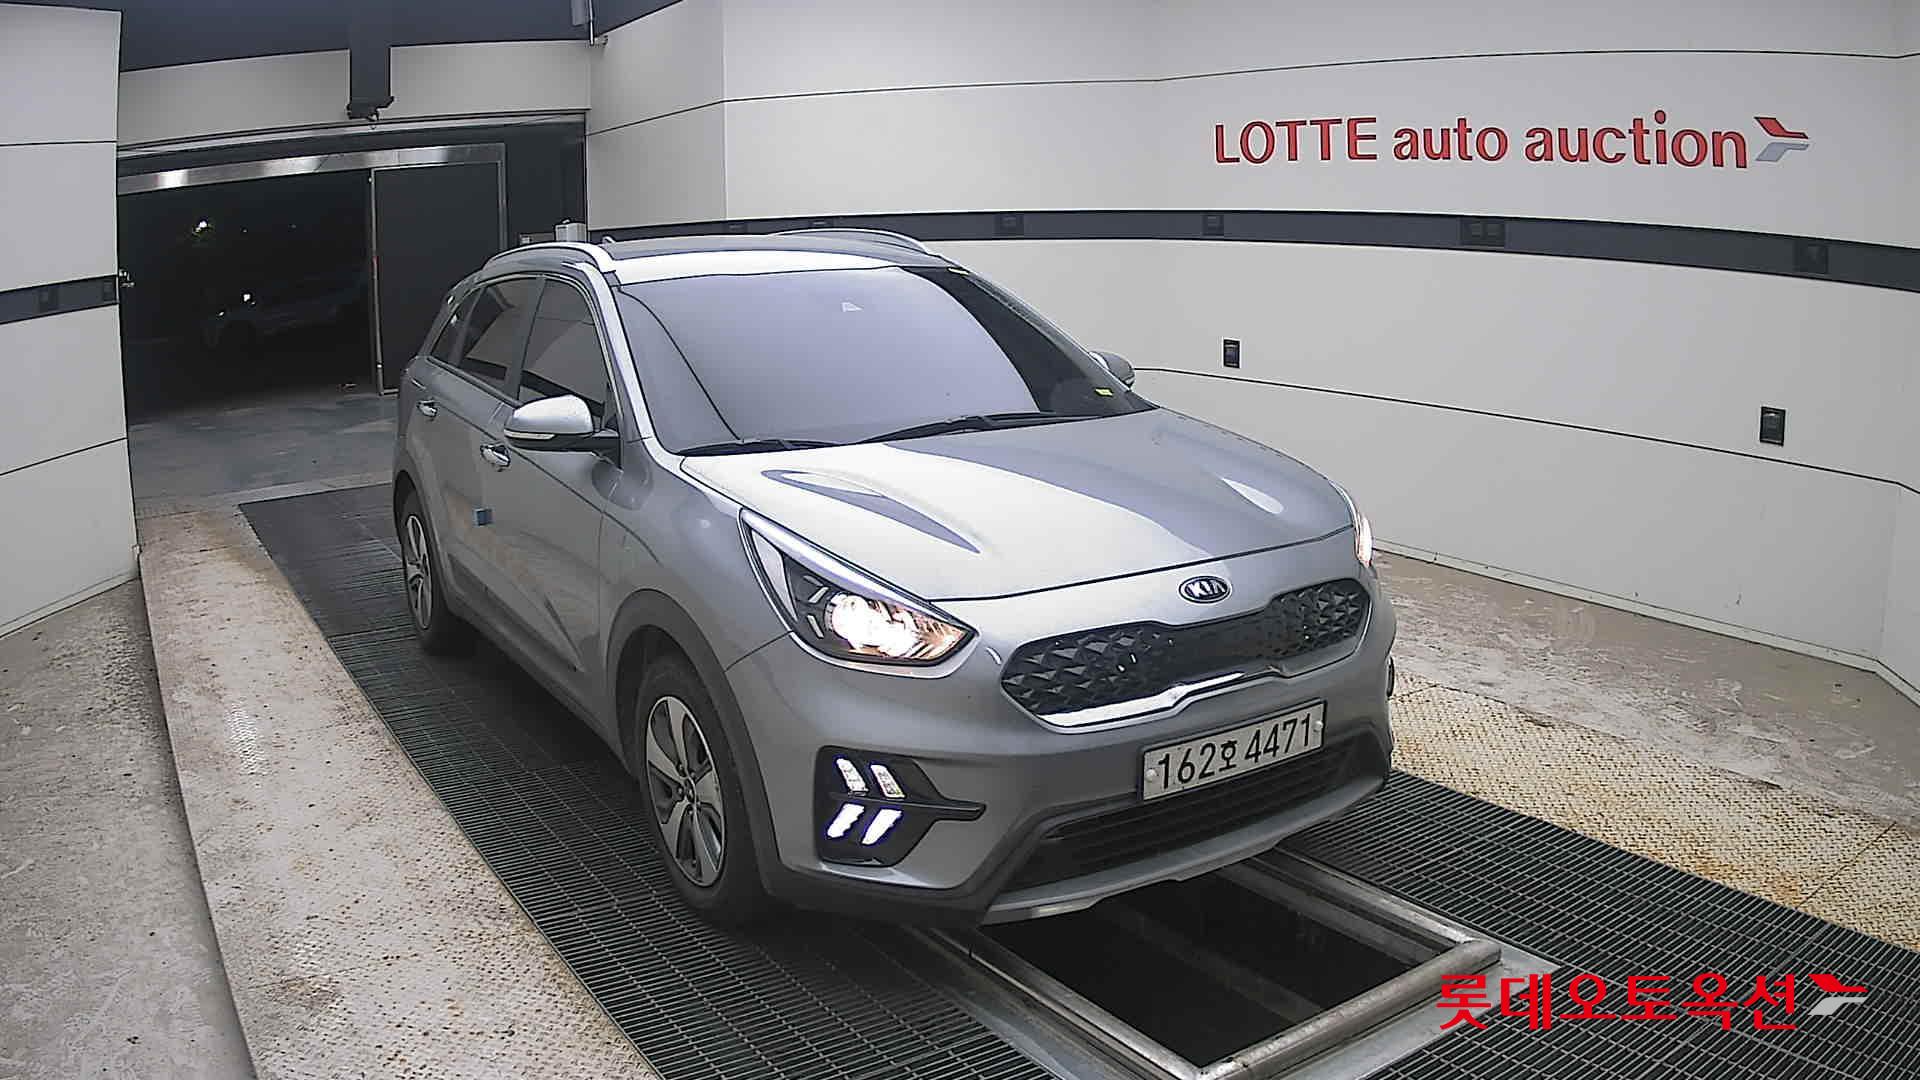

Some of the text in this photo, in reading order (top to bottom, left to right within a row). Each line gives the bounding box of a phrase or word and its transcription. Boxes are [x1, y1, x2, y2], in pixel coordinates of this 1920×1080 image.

[1214, 109, 1748, 169] LOTTE auto auction
[1186, 579, 1226, 598] KIA
[1244, 712, 1311, 764] 4471
